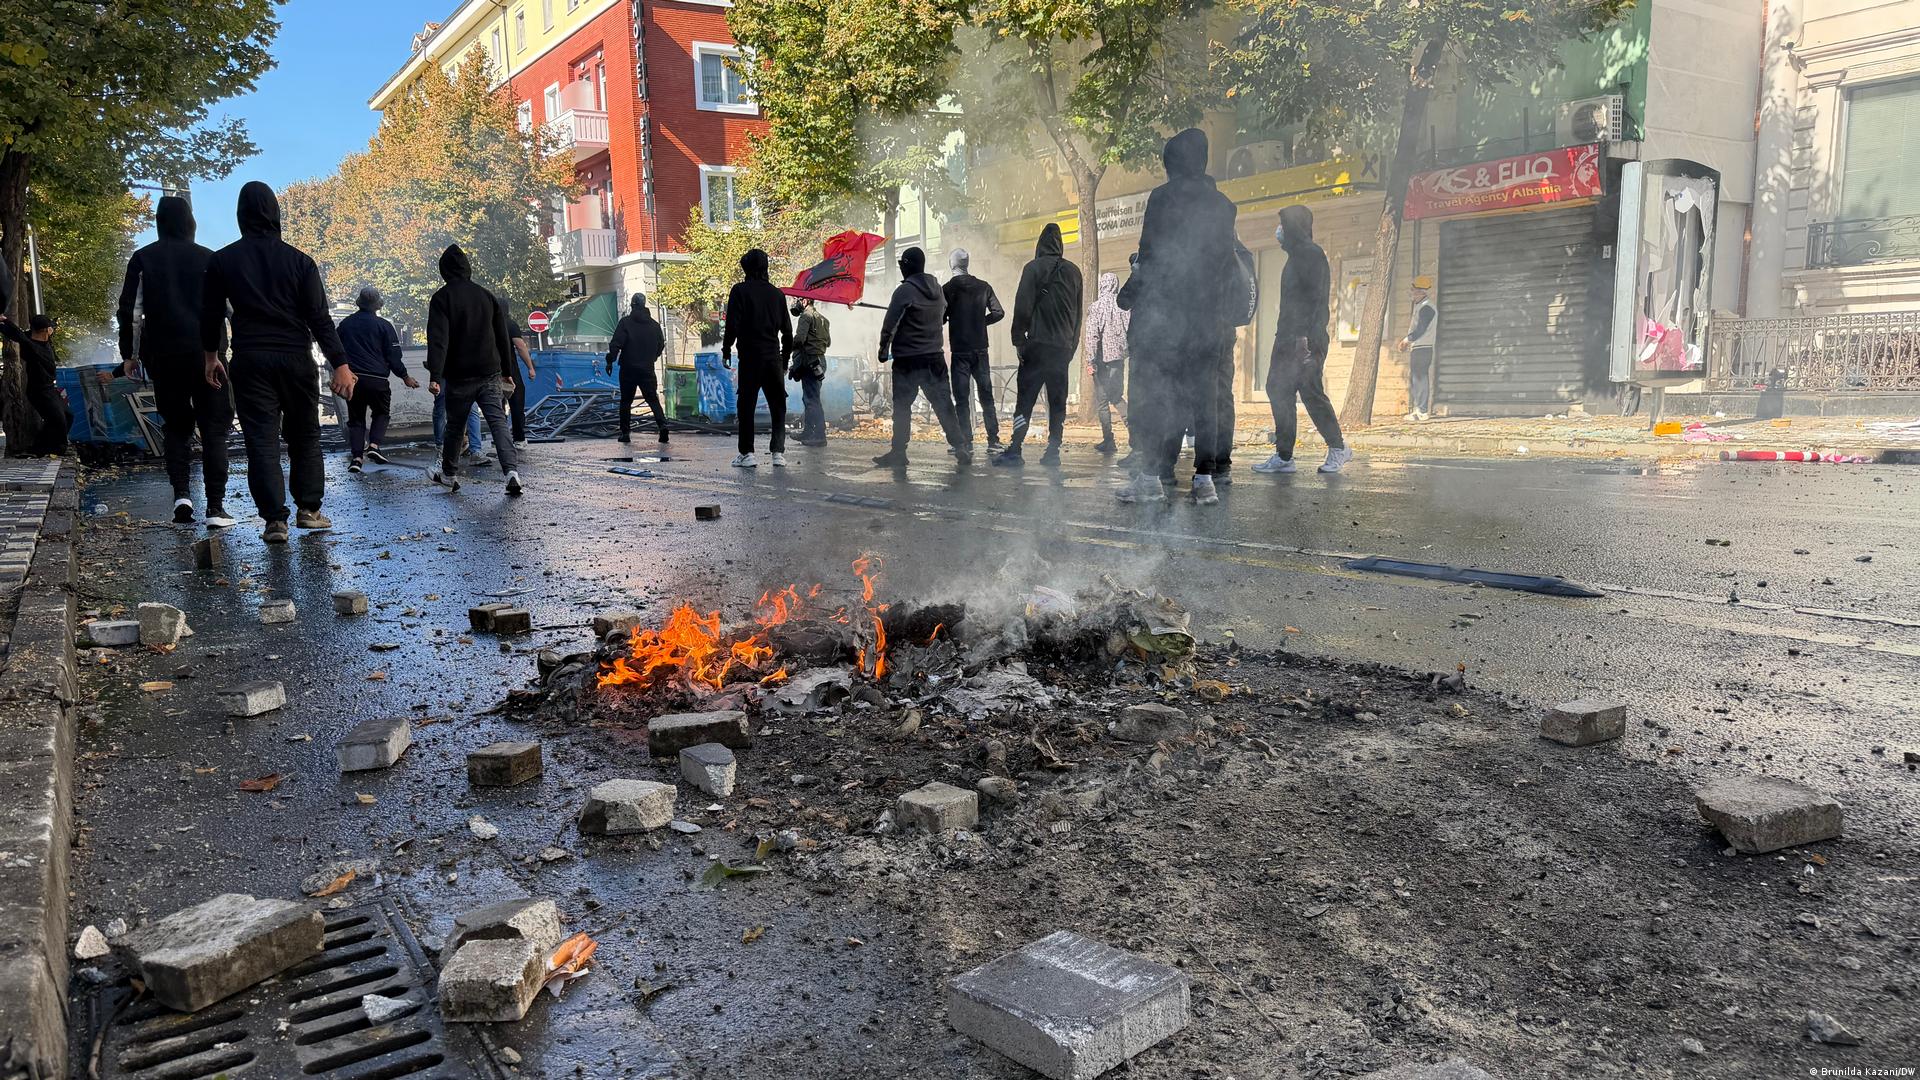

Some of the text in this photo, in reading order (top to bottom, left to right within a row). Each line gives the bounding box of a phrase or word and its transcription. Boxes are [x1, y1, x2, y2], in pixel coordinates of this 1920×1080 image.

[1474, 167, 1491, 187] &
[1425, 184, 1562, 209] Travel Agency Albania
[1135, 200, 1147, 213] BA
[1119, 215, 1144, 228] DIGJIT
